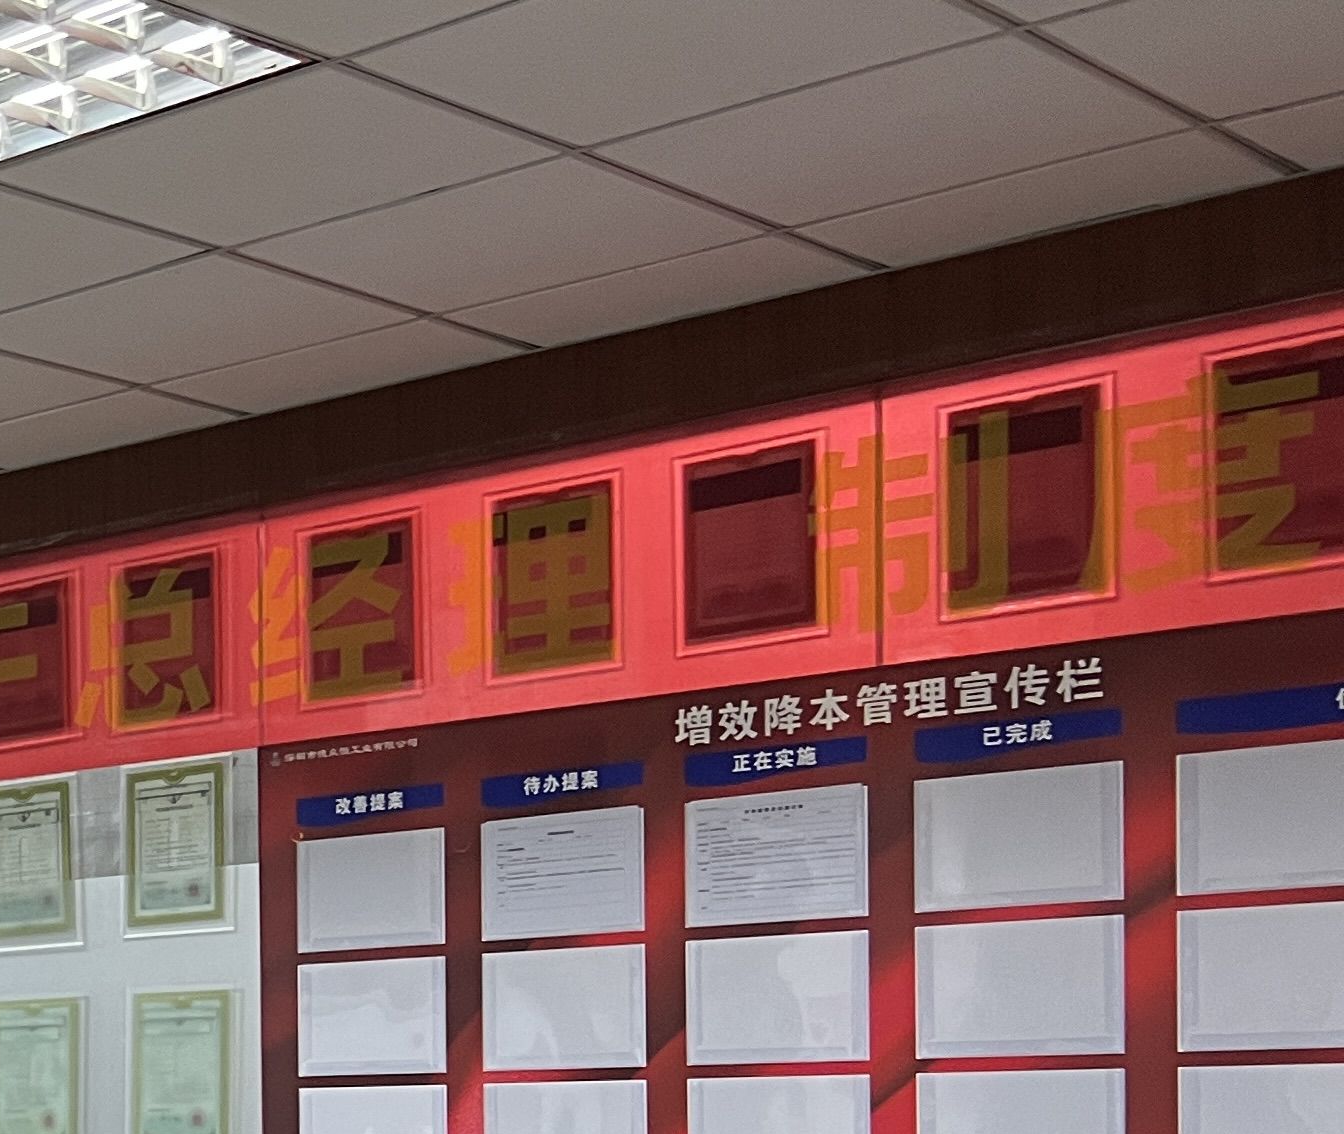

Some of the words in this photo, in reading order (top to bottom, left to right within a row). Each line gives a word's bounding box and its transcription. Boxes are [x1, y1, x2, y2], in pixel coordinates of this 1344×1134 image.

[812, 370, 1322, 634] 制度
[674, 658, 1105, 747] 增效降本管理宣传栏
[983, 720, 1054, 747] 已完成
[731, 746, 818, 774] 正在实施
[522, 770, 600, 797] 待办提案
[334, 791, 405, 817] 改善提案
